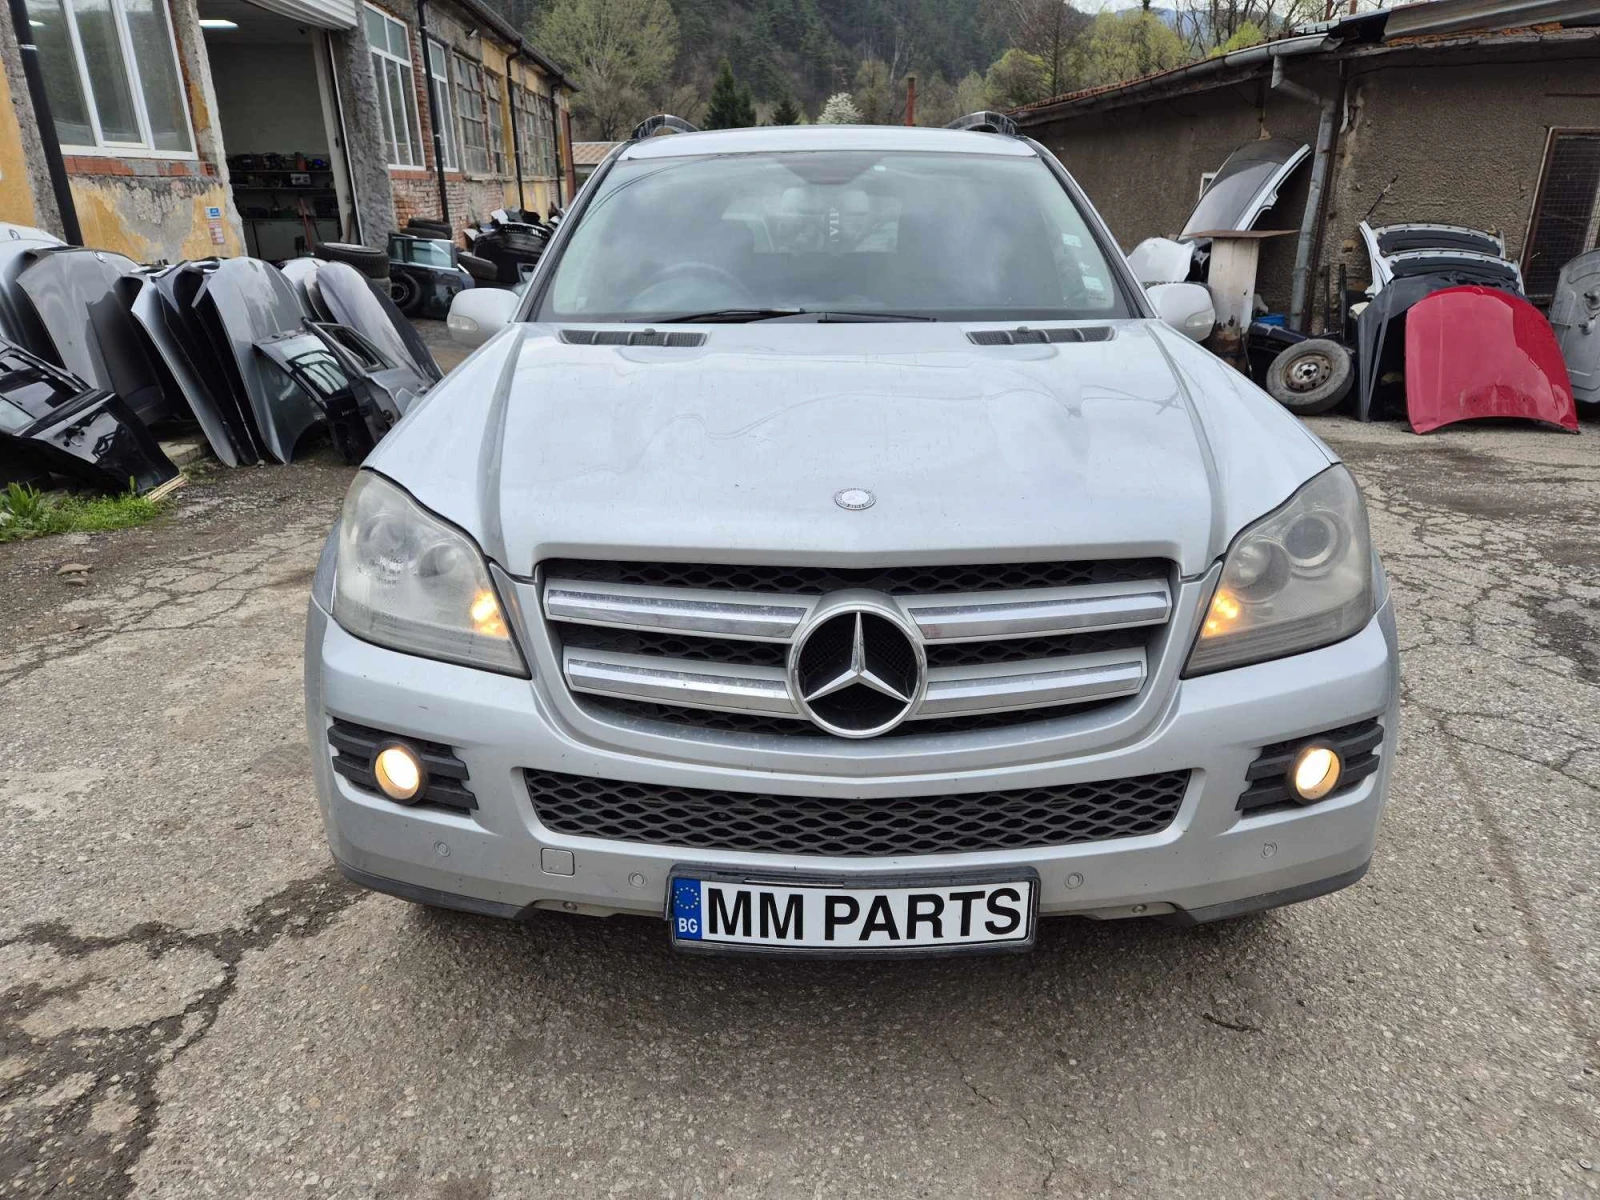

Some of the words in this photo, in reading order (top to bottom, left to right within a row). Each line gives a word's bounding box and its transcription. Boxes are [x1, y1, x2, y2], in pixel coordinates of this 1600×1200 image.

[678, 917, 698, 934] BG
[708, 888, 804, 940] MM
[824, 888, 1022, 941] PARTS
